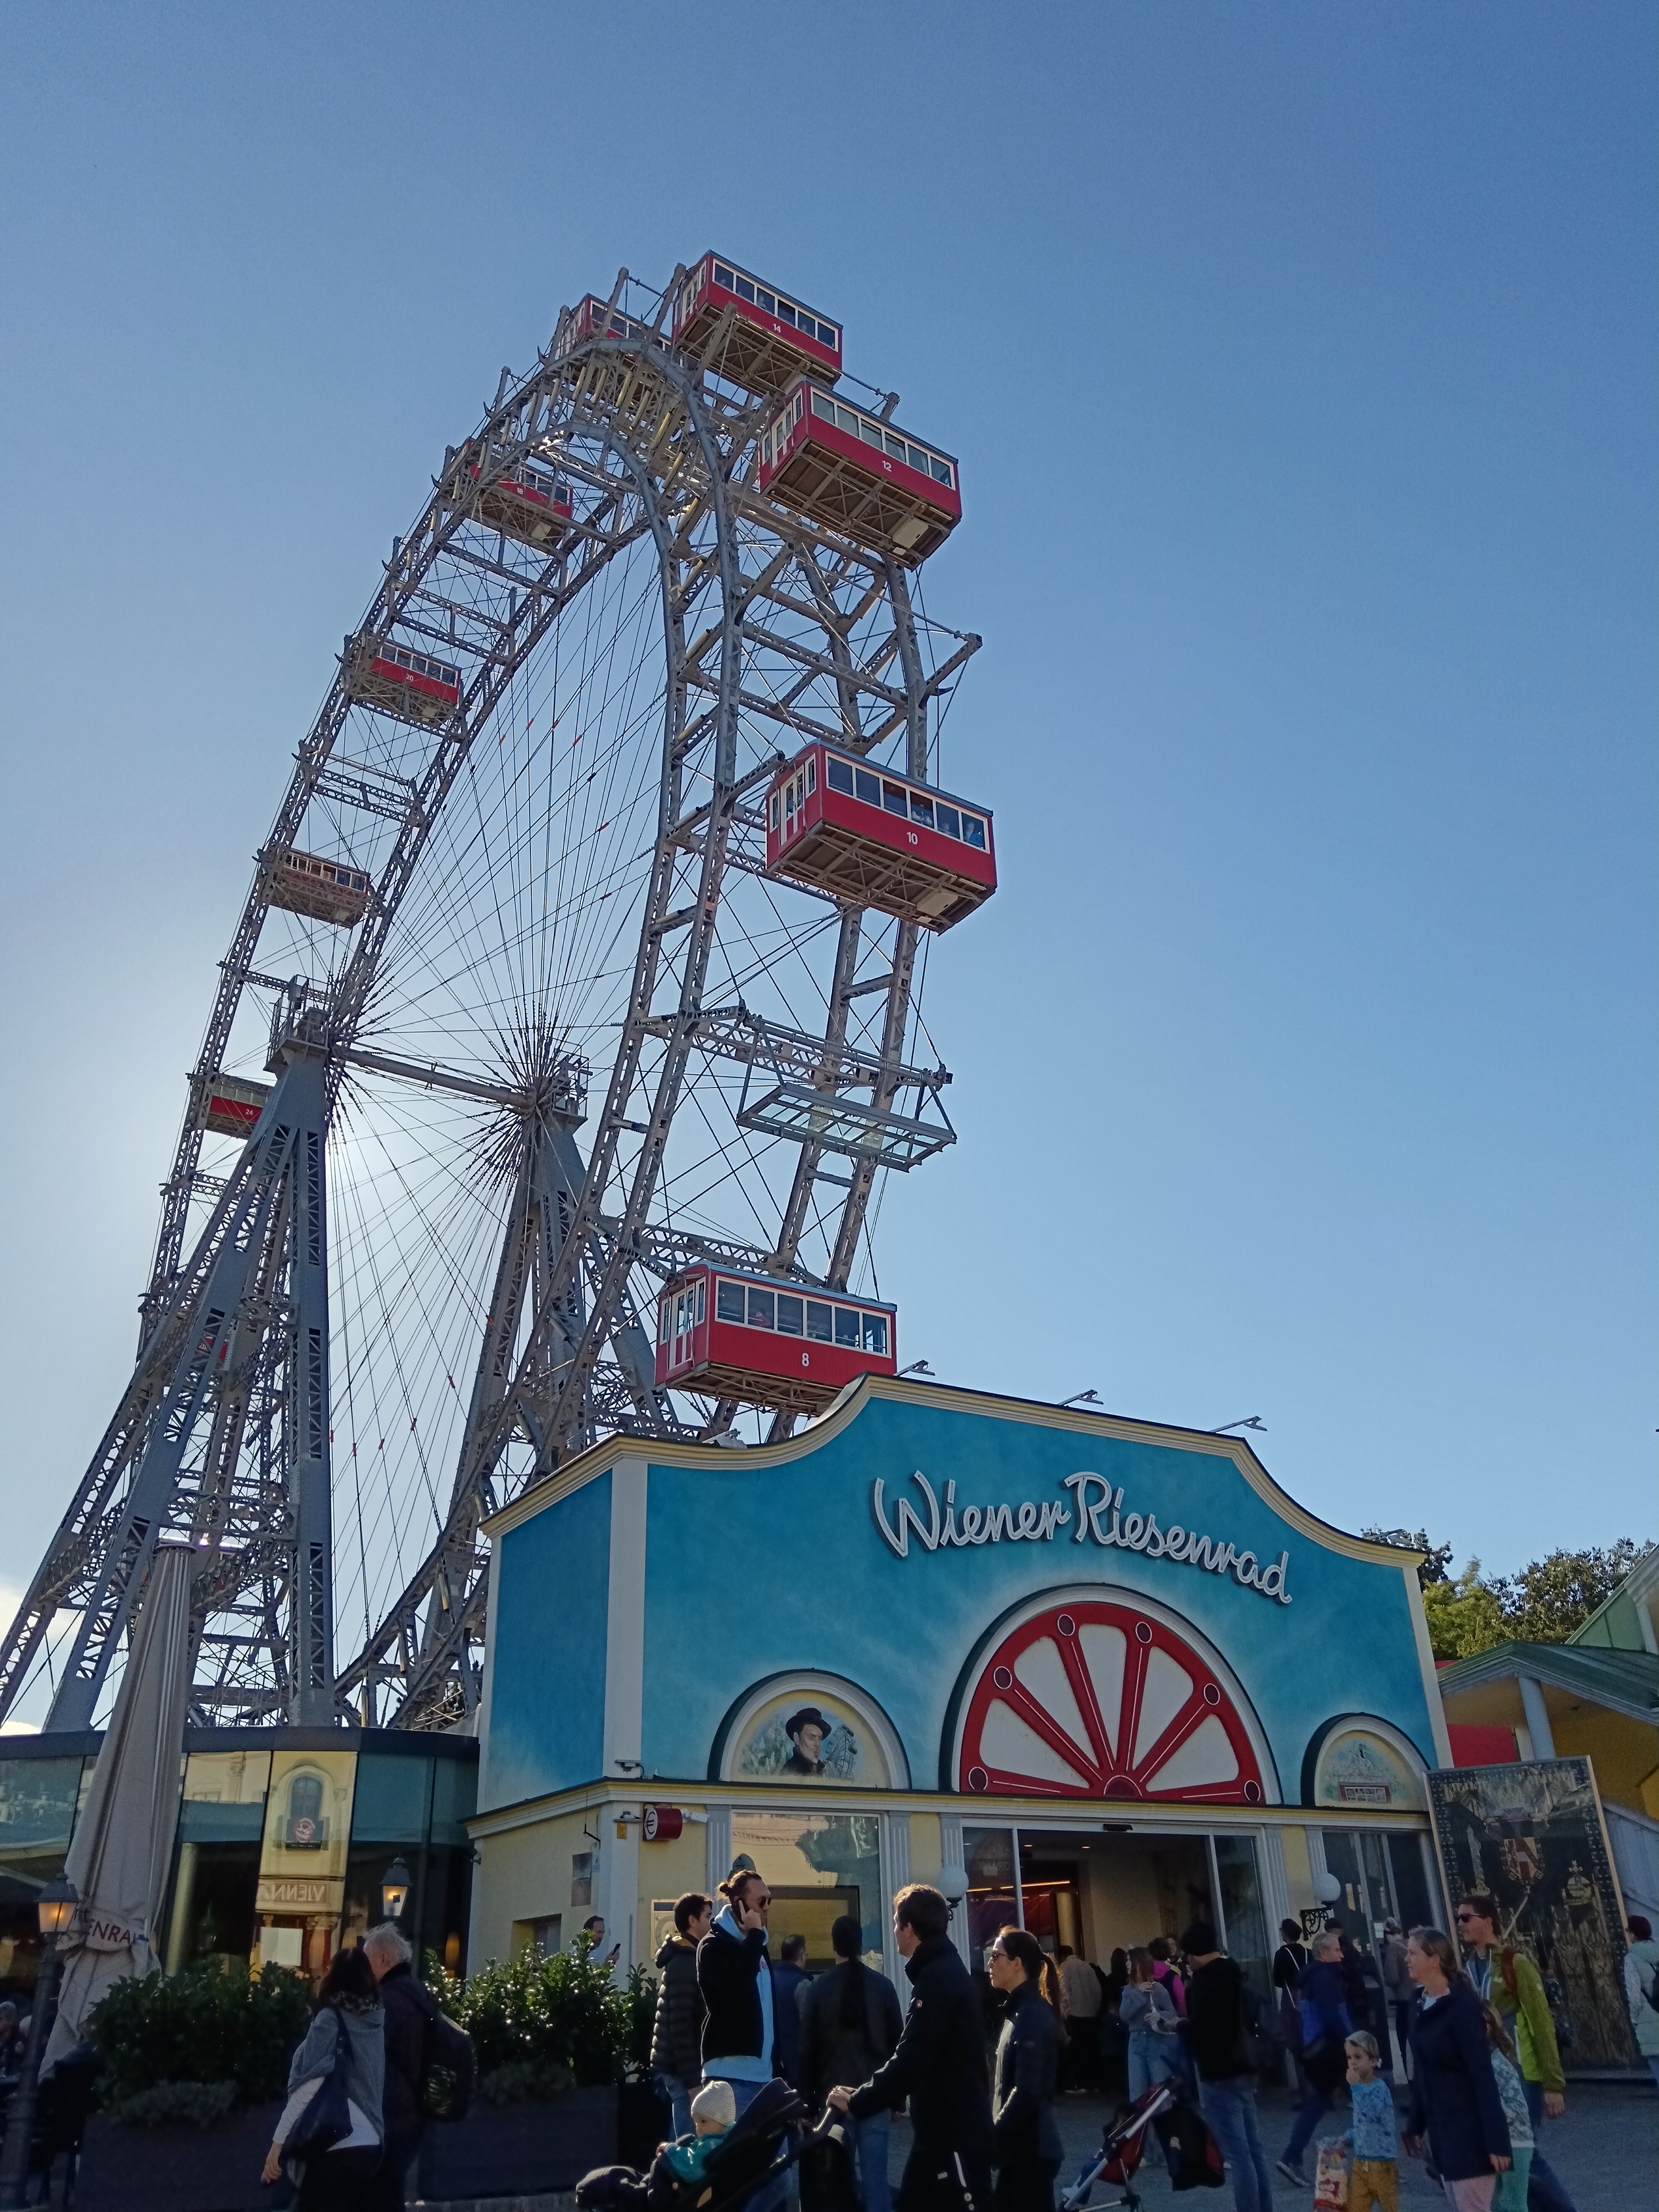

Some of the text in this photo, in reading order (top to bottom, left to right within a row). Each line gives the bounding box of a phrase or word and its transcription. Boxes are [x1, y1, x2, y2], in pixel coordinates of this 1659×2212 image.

[772, 323, 781, 333] 14
[882, 460, 892, 472] 12
[906, 831, 918, 845] 10
[802, 1352, 809, 1367] 8
[871, 1470, 1292, 1605] Wiener Riesenrad
